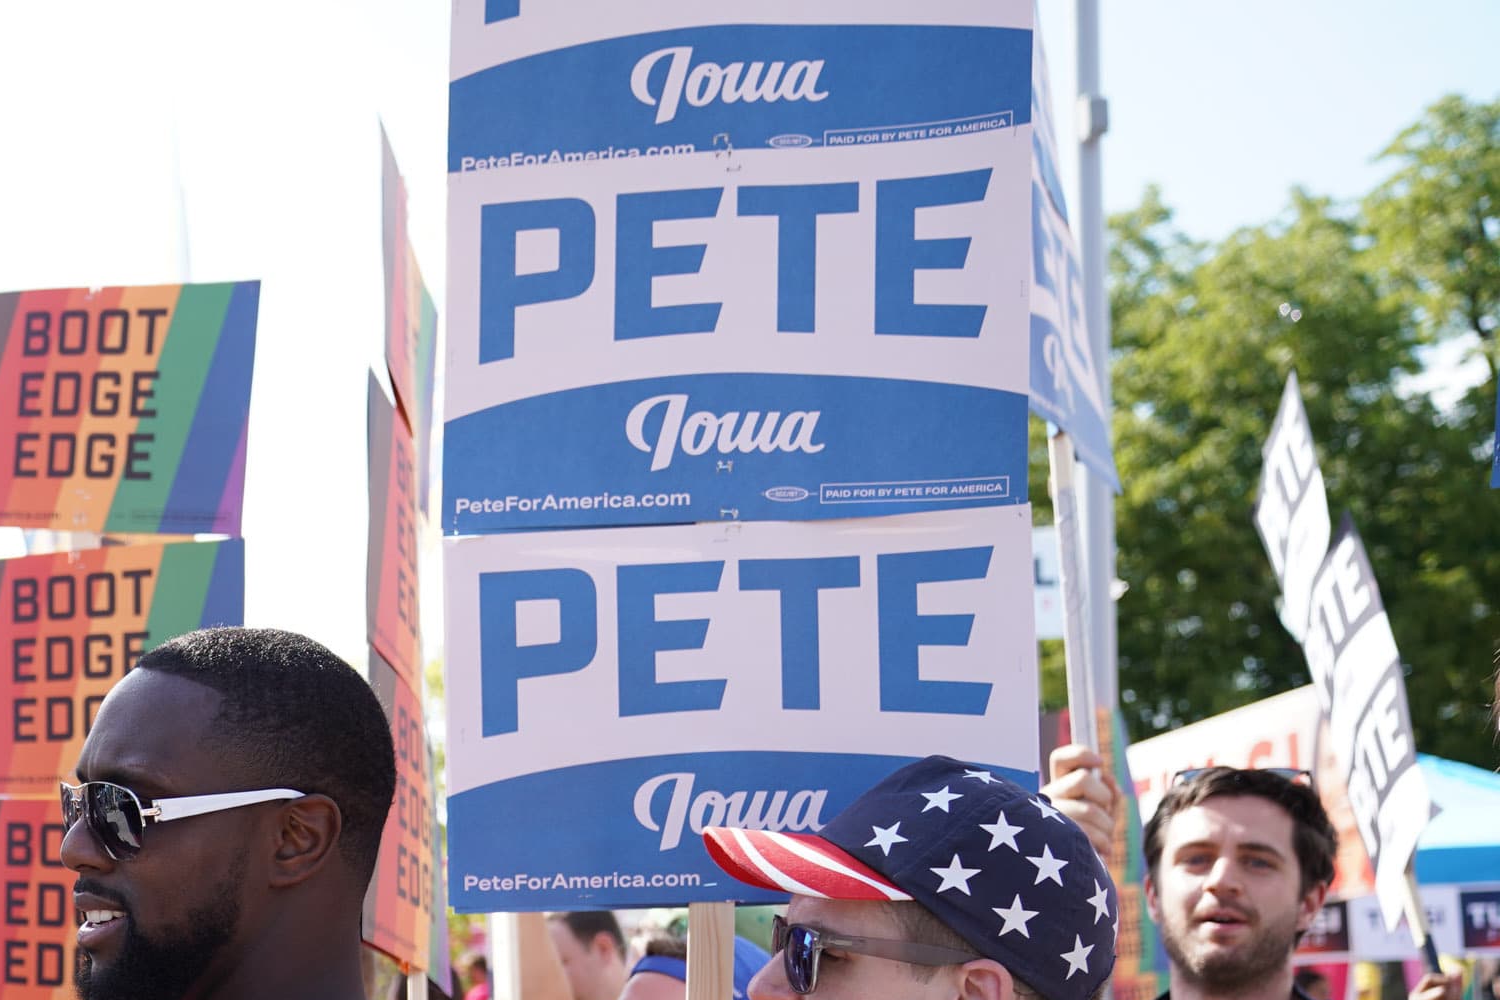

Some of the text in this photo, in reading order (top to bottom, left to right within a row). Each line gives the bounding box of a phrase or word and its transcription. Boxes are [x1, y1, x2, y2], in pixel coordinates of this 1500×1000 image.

[631, 46, 829, 125] Iowa
[829, 118, 1007, 147] PAID FOR BY PETE FOR AMERICA
[479, 167, 994, 365] PETE
[23, 308, 167, 357] BOOT
[17, 371, 160, 417] EDGE
[13, 432, 155, 480] EDGE
[625, 394, 826, 472] Iowa
[456, 491, 691, 514] PeteForAmerica.com
[826, 482, 1003, 499] PAID FOR BY PETE FOR AMERICA
[13, 569, 153, 624] BOOT
[479, 545, 995, 738] PETE
[633, 773, 828, 852] Iowa
[6, 822, 66, 867] BO
[5, 882, 68, 927] ED
[464, 872, 700, 891] PeteForAmerica.com
[4, 940, 67, 986] ED
